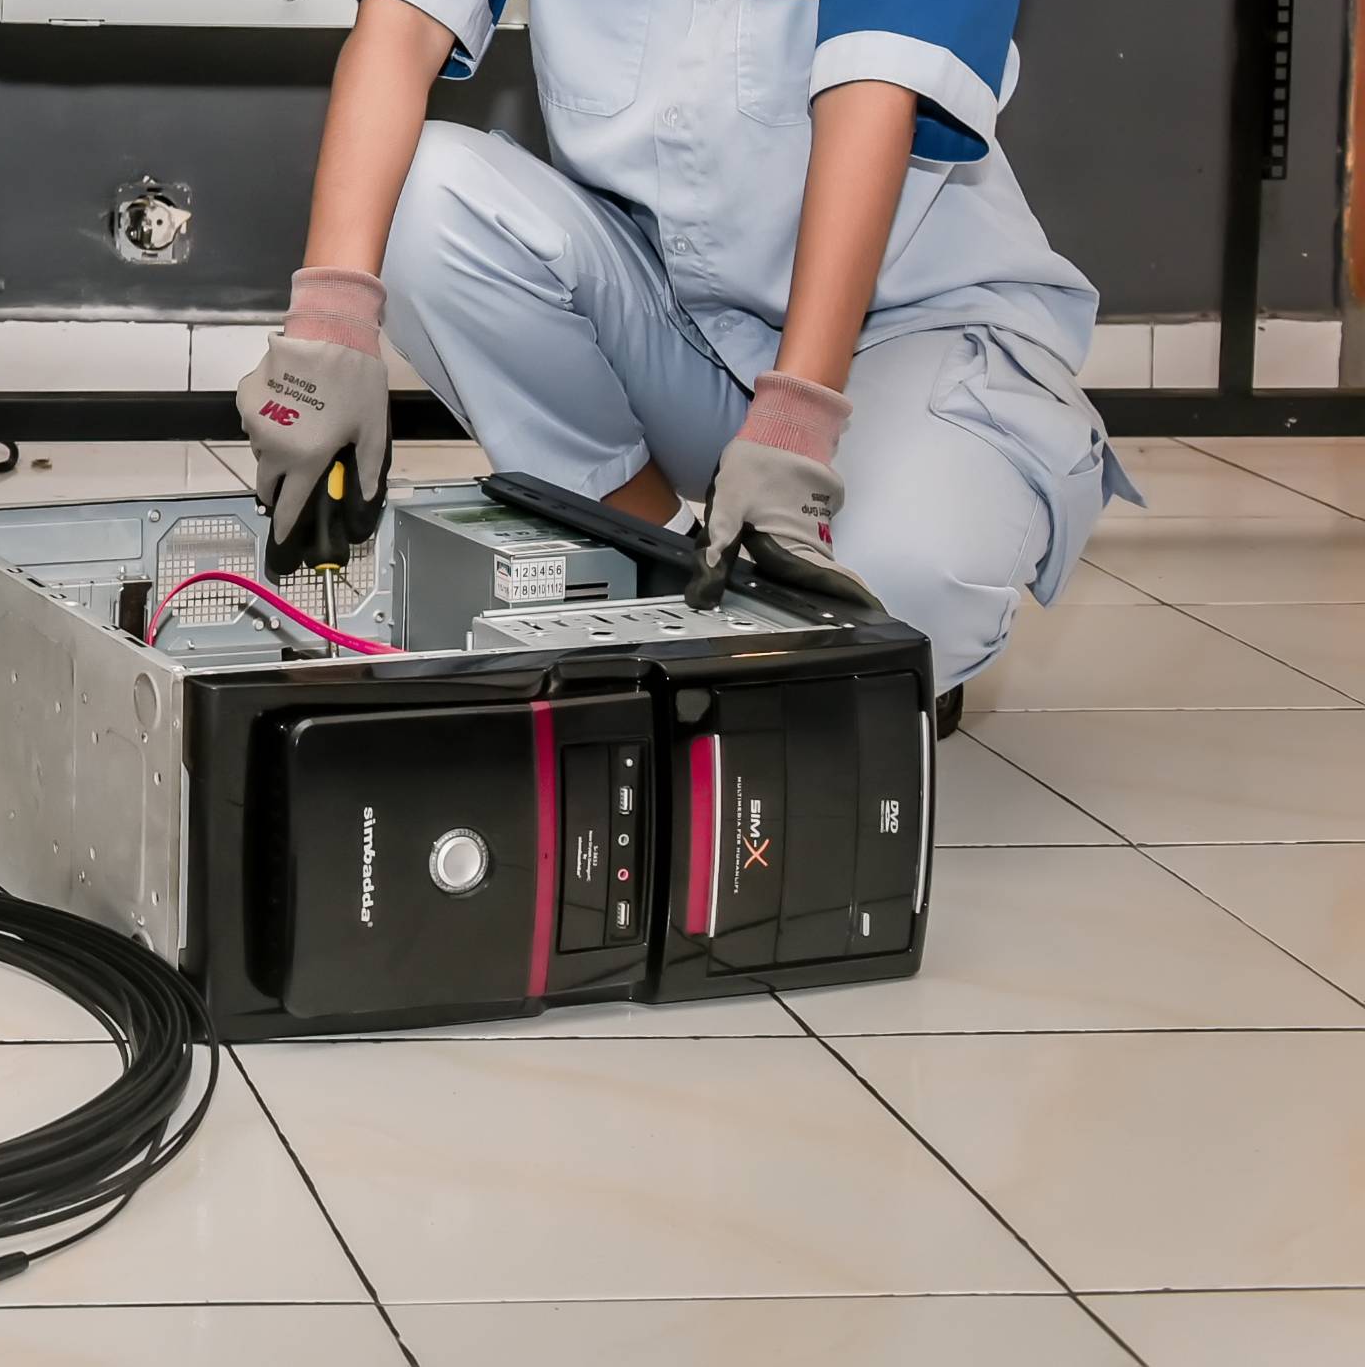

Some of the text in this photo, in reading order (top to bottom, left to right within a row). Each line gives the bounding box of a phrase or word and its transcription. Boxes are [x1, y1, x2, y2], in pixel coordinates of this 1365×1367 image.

[283, 372, 317, 394] Gloves
[284, 387, 325, 411] Comfort
[259, 399, 300, 426] 3M
[515, 565, 562, 578] 1 2 3 4 5 6
[513, 586, 519, 596] 7
[522, 585, 528, 596] 8
[531, 585, 537, 595] 9
[538, 584, 545, 594] 10
[547, 584, 554, 594] 11
[555, 583, 562, 593] 12
[890, 800, 899, 834] DVD
[361, 806, 376, 922] simbadda
